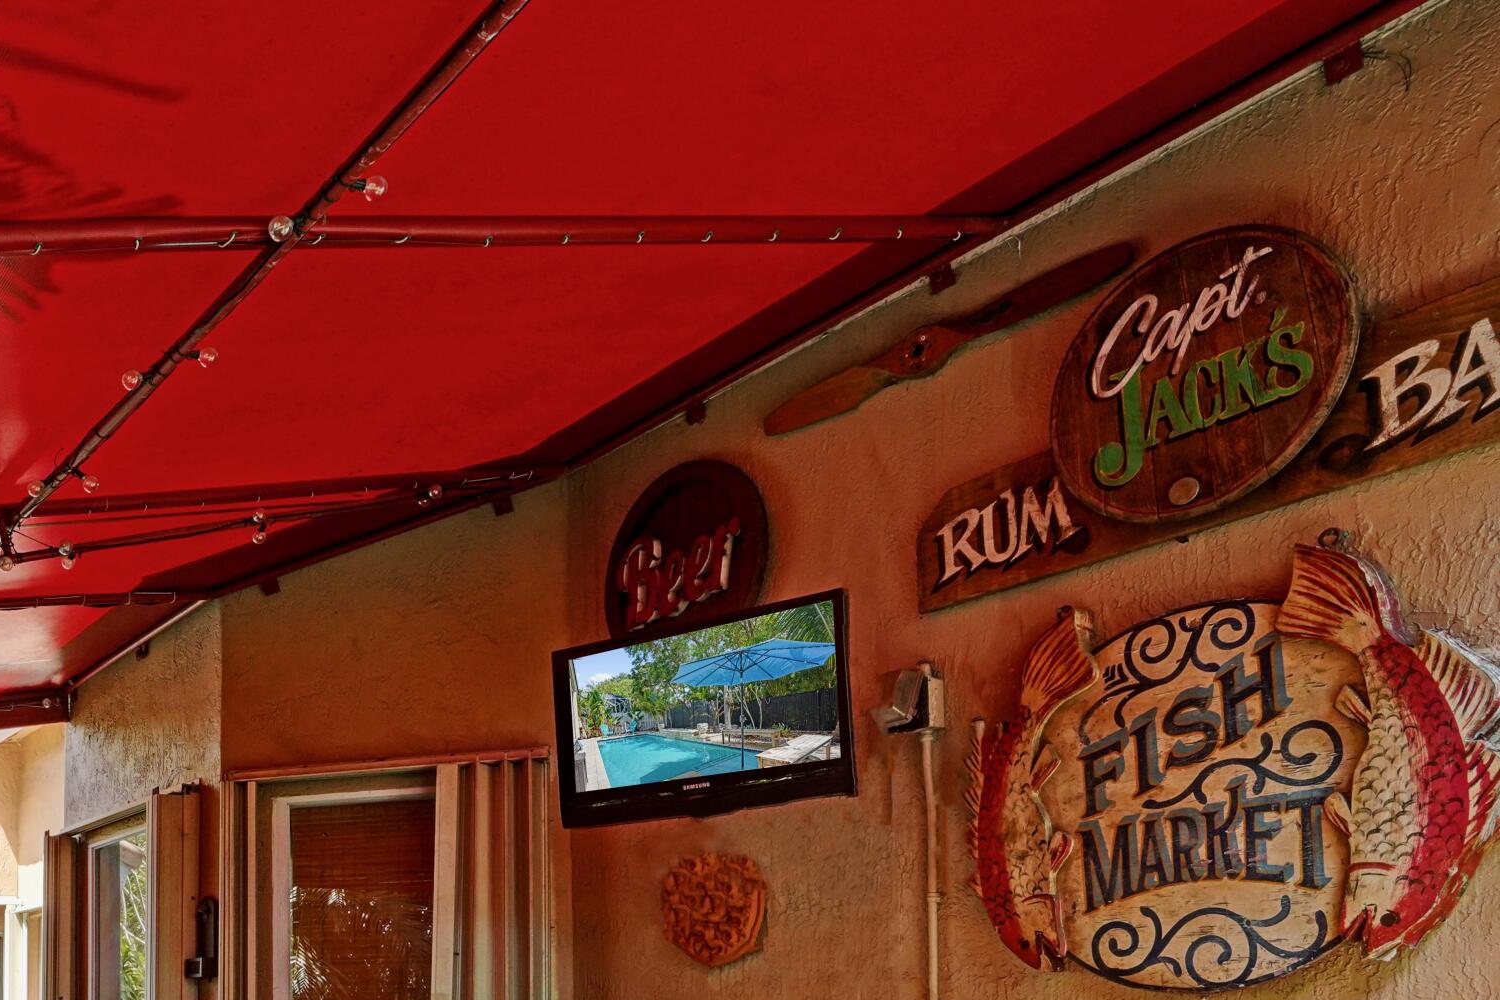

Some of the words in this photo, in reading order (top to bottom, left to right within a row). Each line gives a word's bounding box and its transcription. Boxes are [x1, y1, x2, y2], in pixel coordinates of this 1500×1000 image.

[1093, 246, 1273, 399] Capt.
[1094, 306, 1314, 486] JACK'S
[617, 517, 741, 632] Beer
[934, 475, 1084, 585] RUM
[1077, 635, 1293, 817] FISH
[1077, 776, 1333, 913] MARKET
